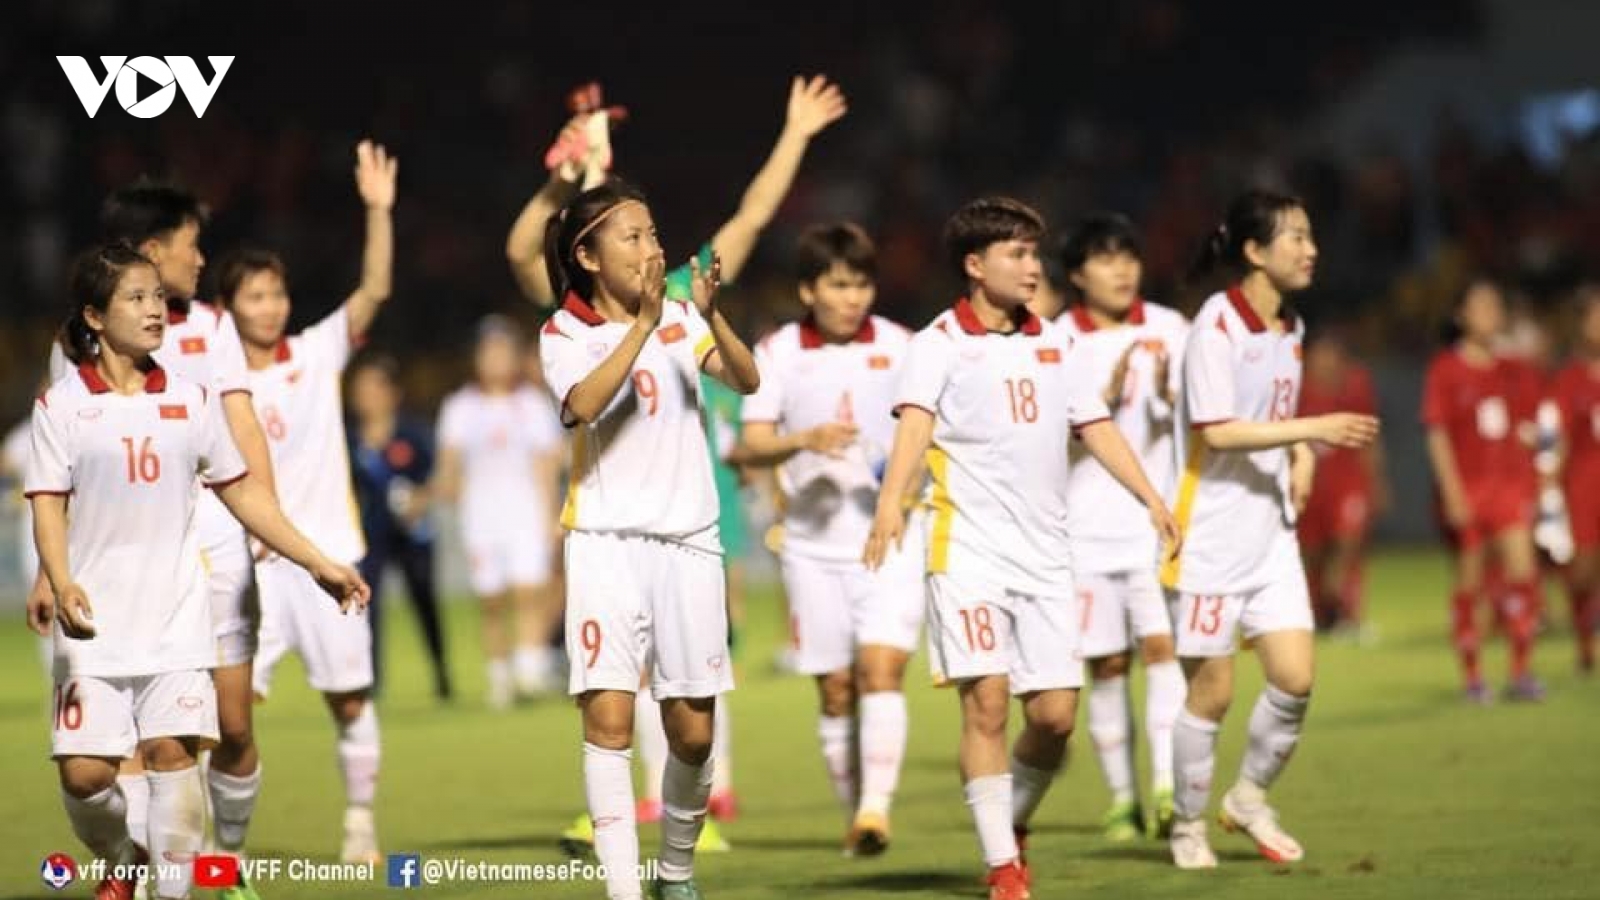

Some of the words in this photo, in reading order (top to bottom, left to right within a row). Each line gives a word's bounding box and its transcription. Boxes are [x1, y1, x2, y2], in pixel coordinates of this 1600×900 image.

[633, 369, 657, 416] 9
[1004, 377, 1038, 423] 18
[121, 436, 161, 484] 16
[958, 606, 996, 652] 18
[1189, 594, 1223, 635] 13
[582, 620, 601, 669] 9
